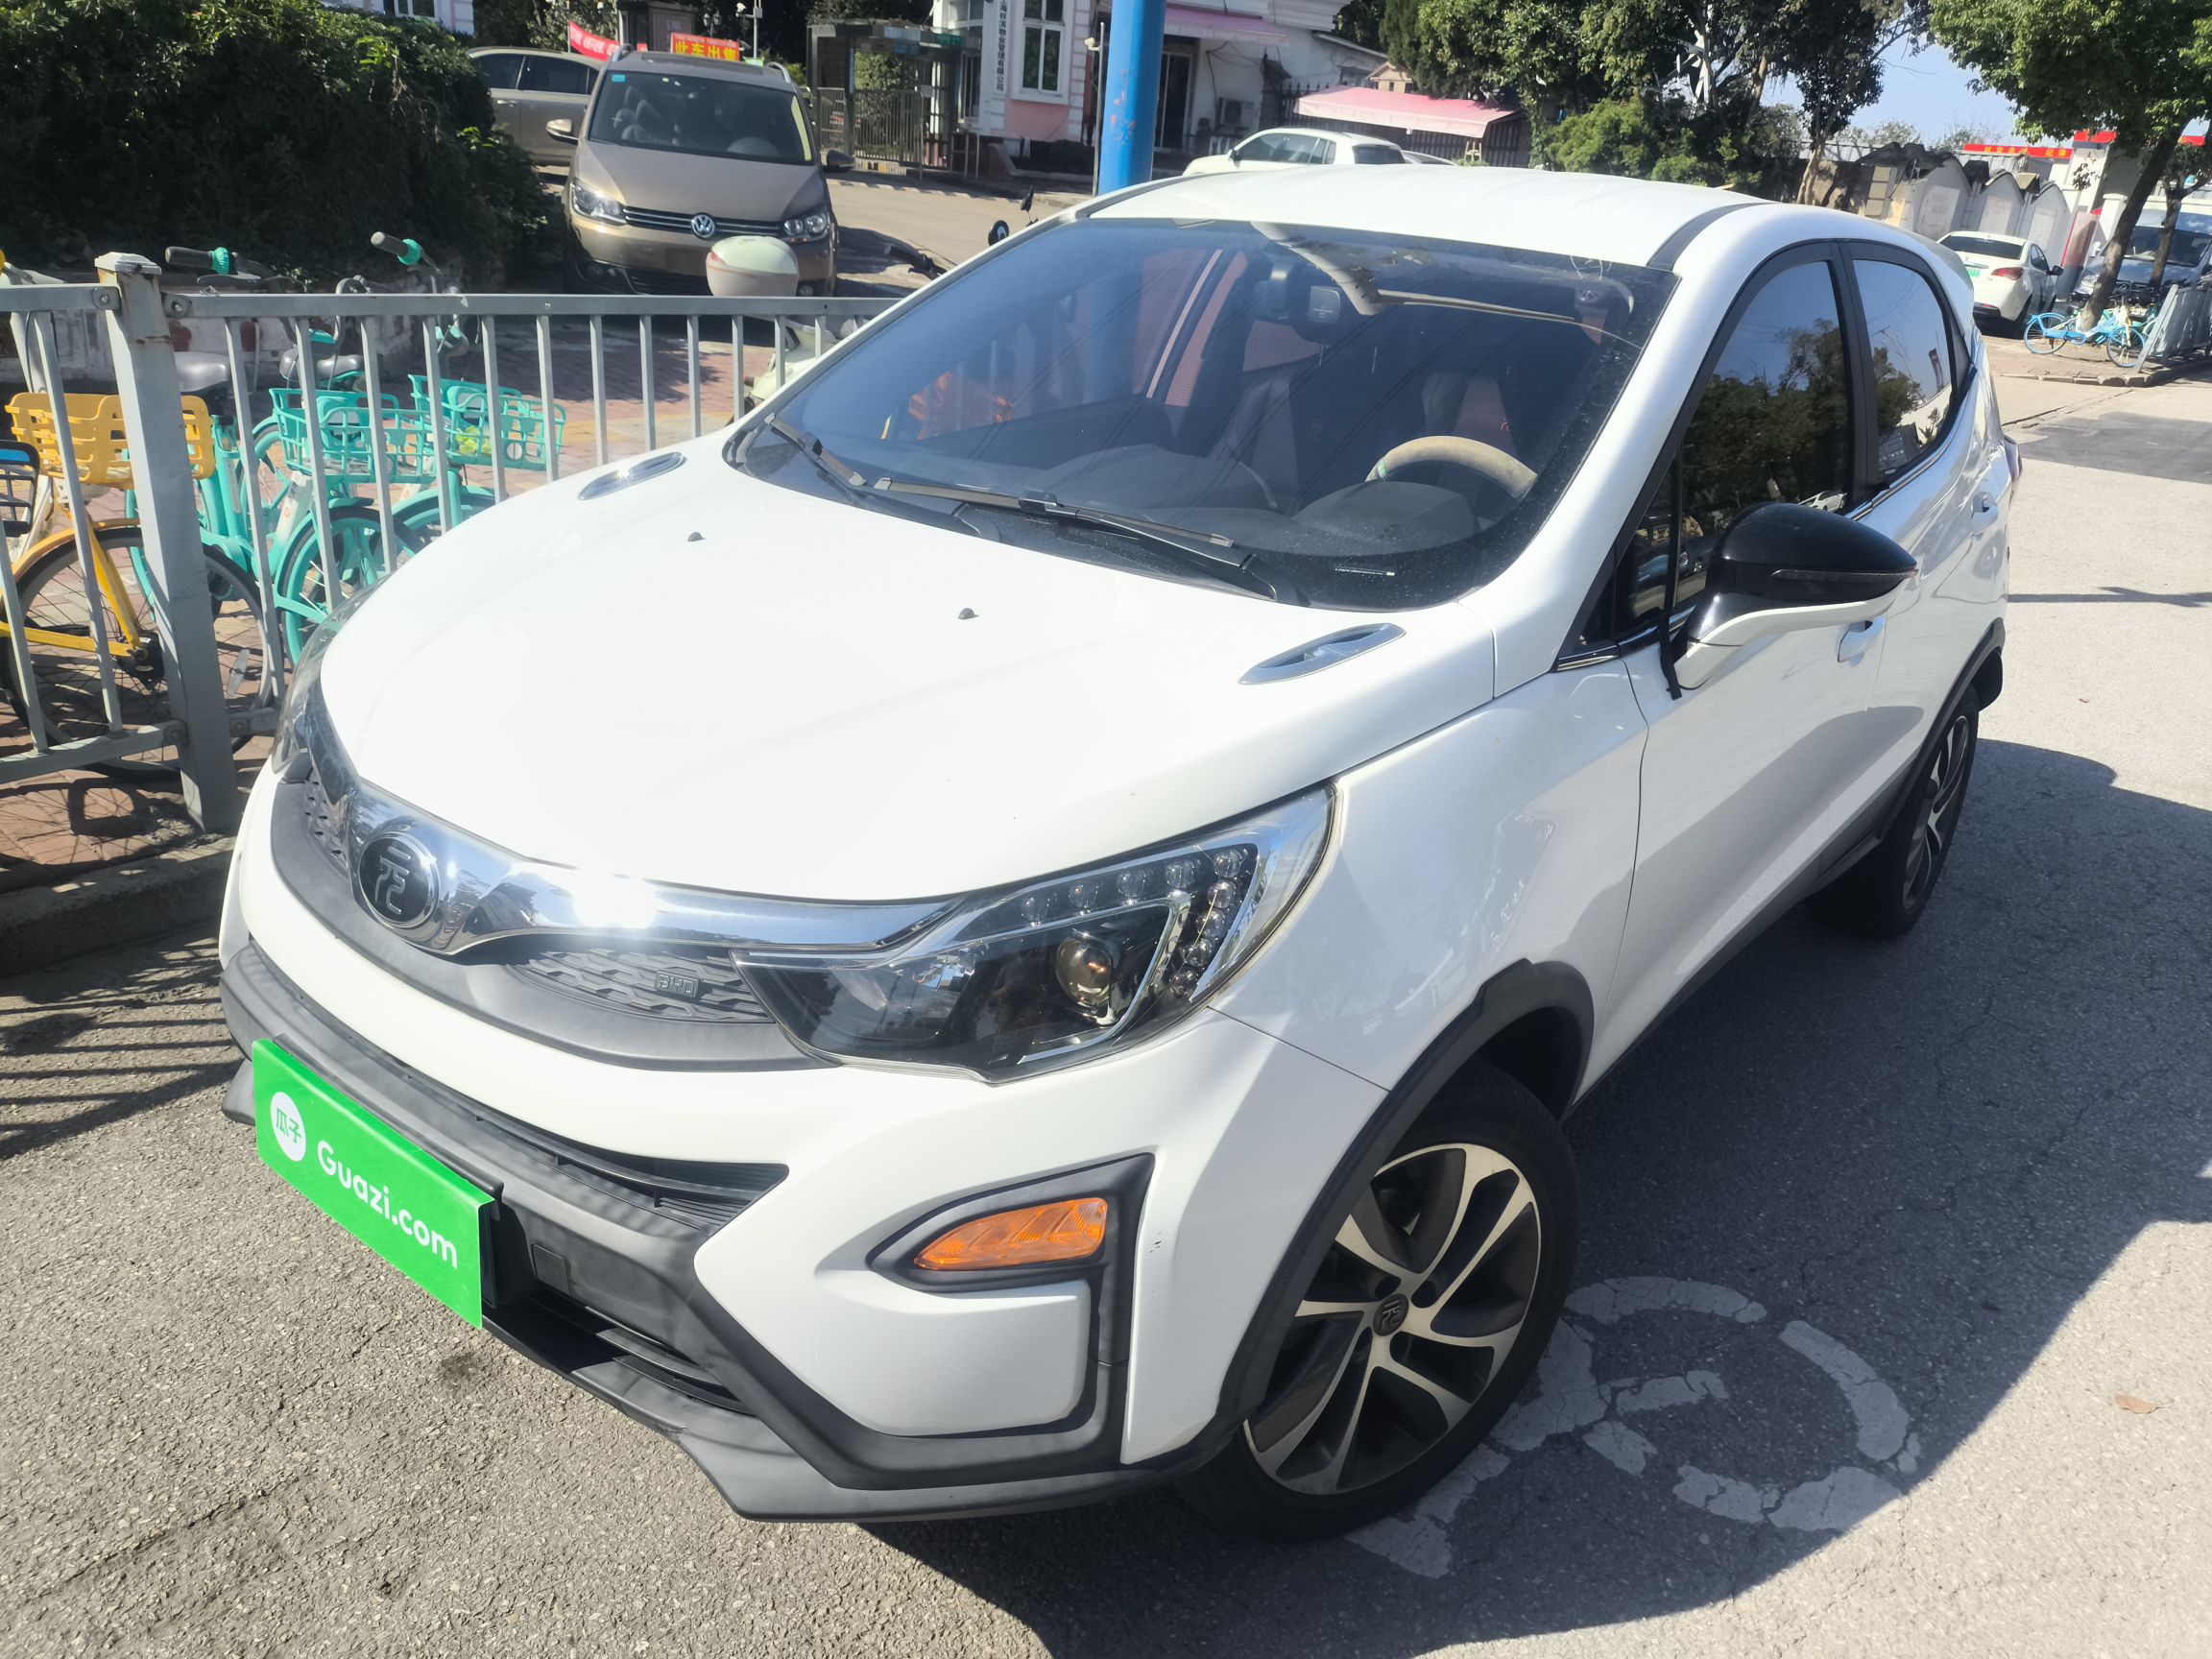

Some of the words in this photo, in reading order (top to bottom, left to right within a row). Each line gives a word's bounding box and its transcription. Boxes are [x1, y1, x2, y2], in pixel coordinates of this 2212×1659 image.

[658, 974, 694, 996] BYD
[276, 1107, 302, 1143] 瓜子
[317, 1140, 458, 1269] Guazi.com
